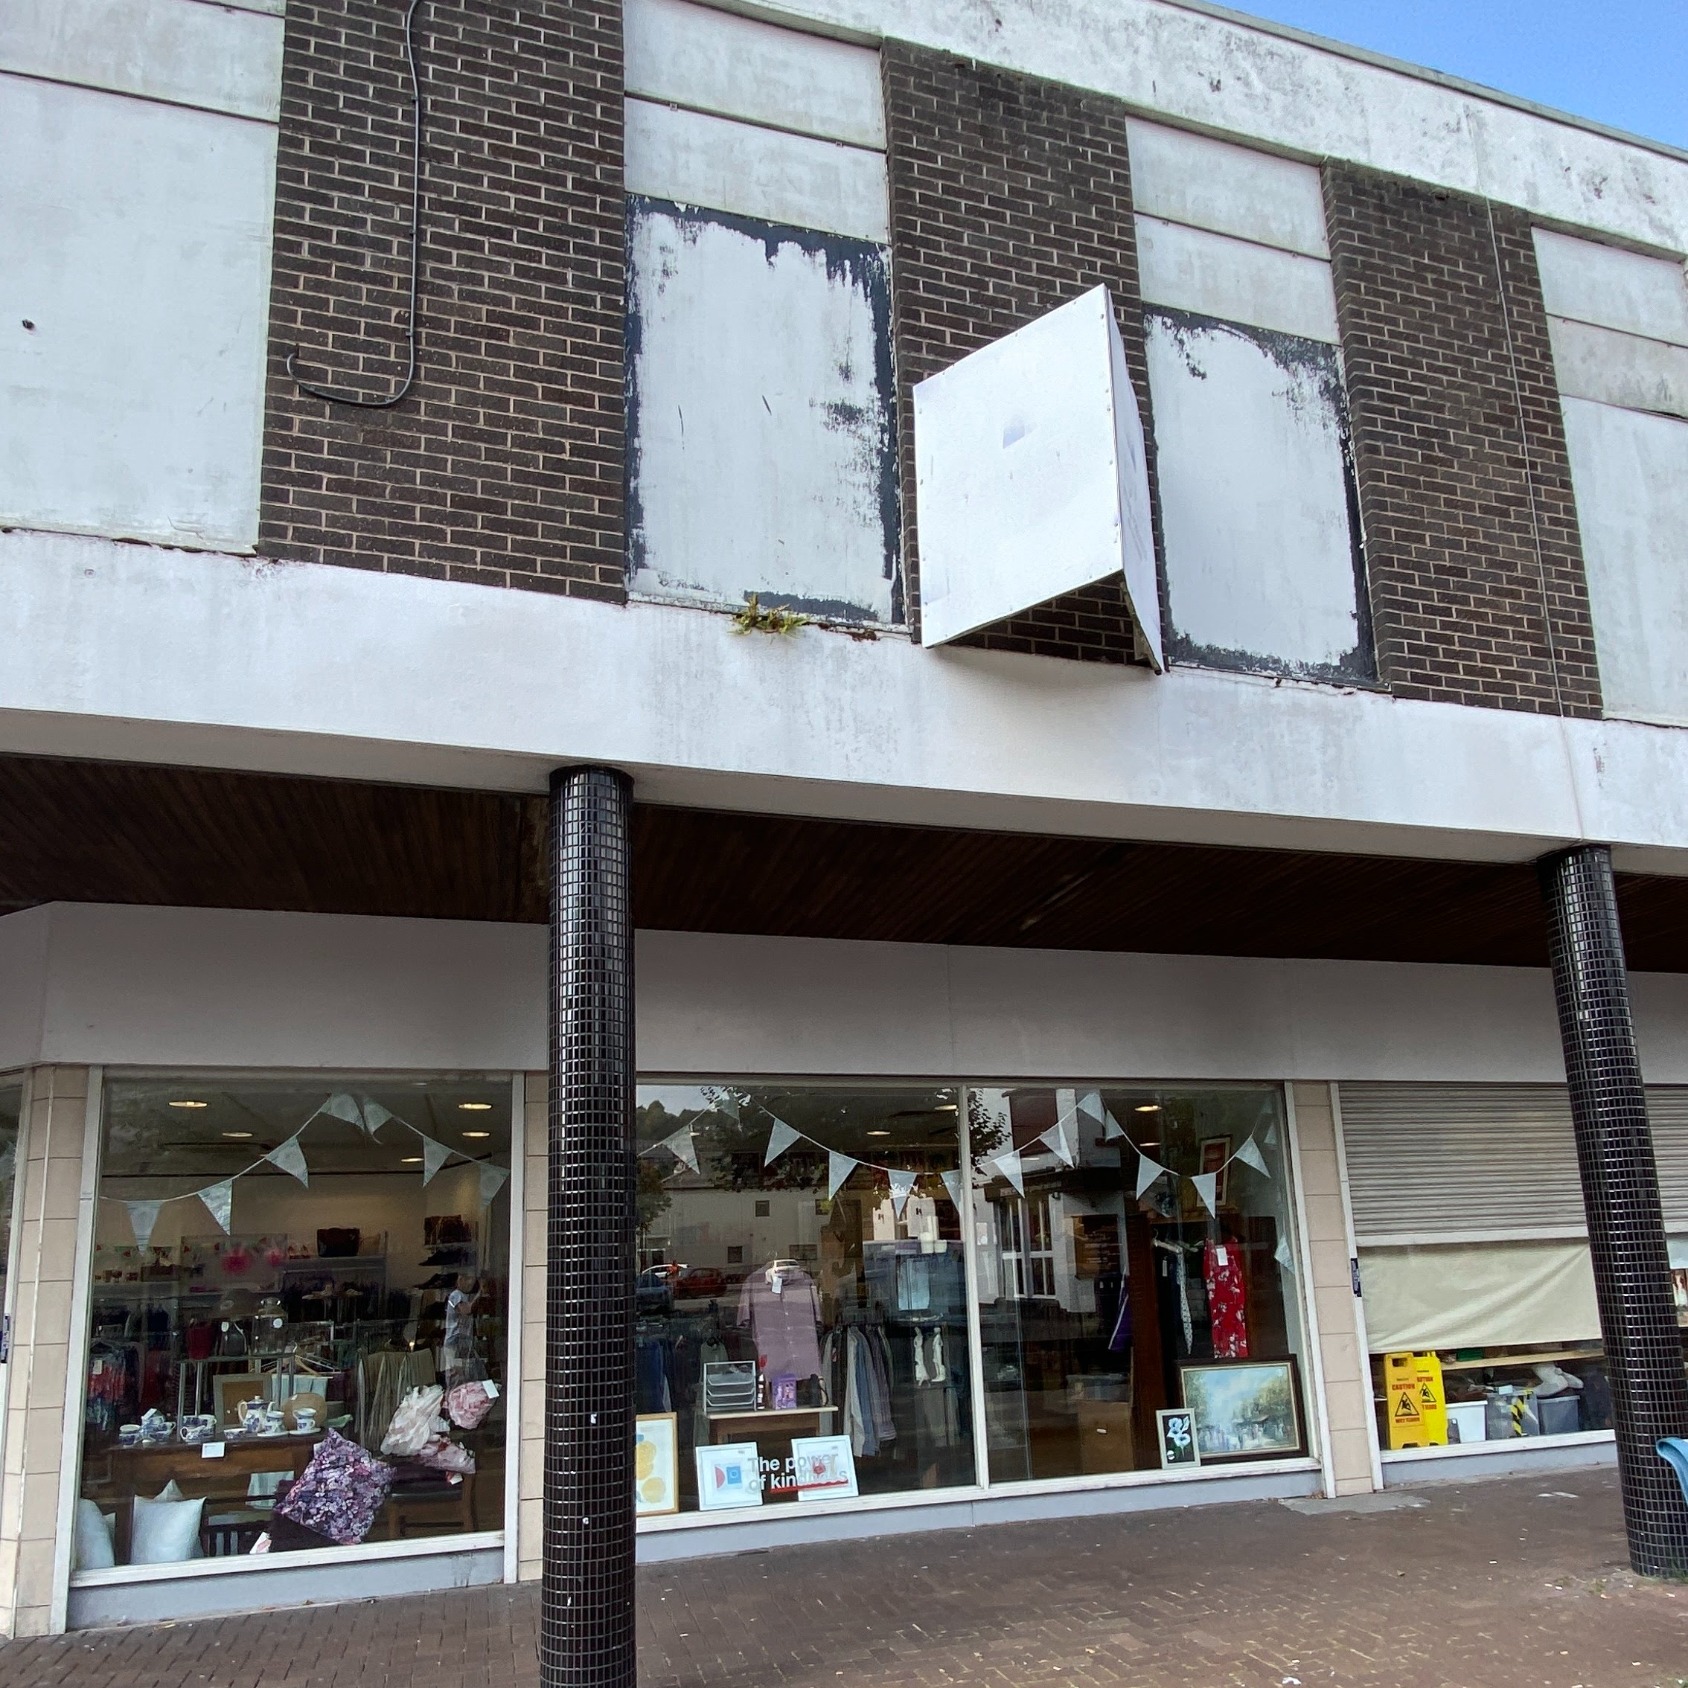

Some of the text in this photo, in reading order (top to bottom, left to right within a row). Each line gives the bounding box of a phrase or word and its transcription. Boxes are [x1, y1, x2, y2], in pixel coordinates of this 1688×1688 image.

[1392, 1383, 1415, 1391] CAUTION
[748, 1454, 839, 1473] The power
[749, 1470, 848, 1491] of kindns
